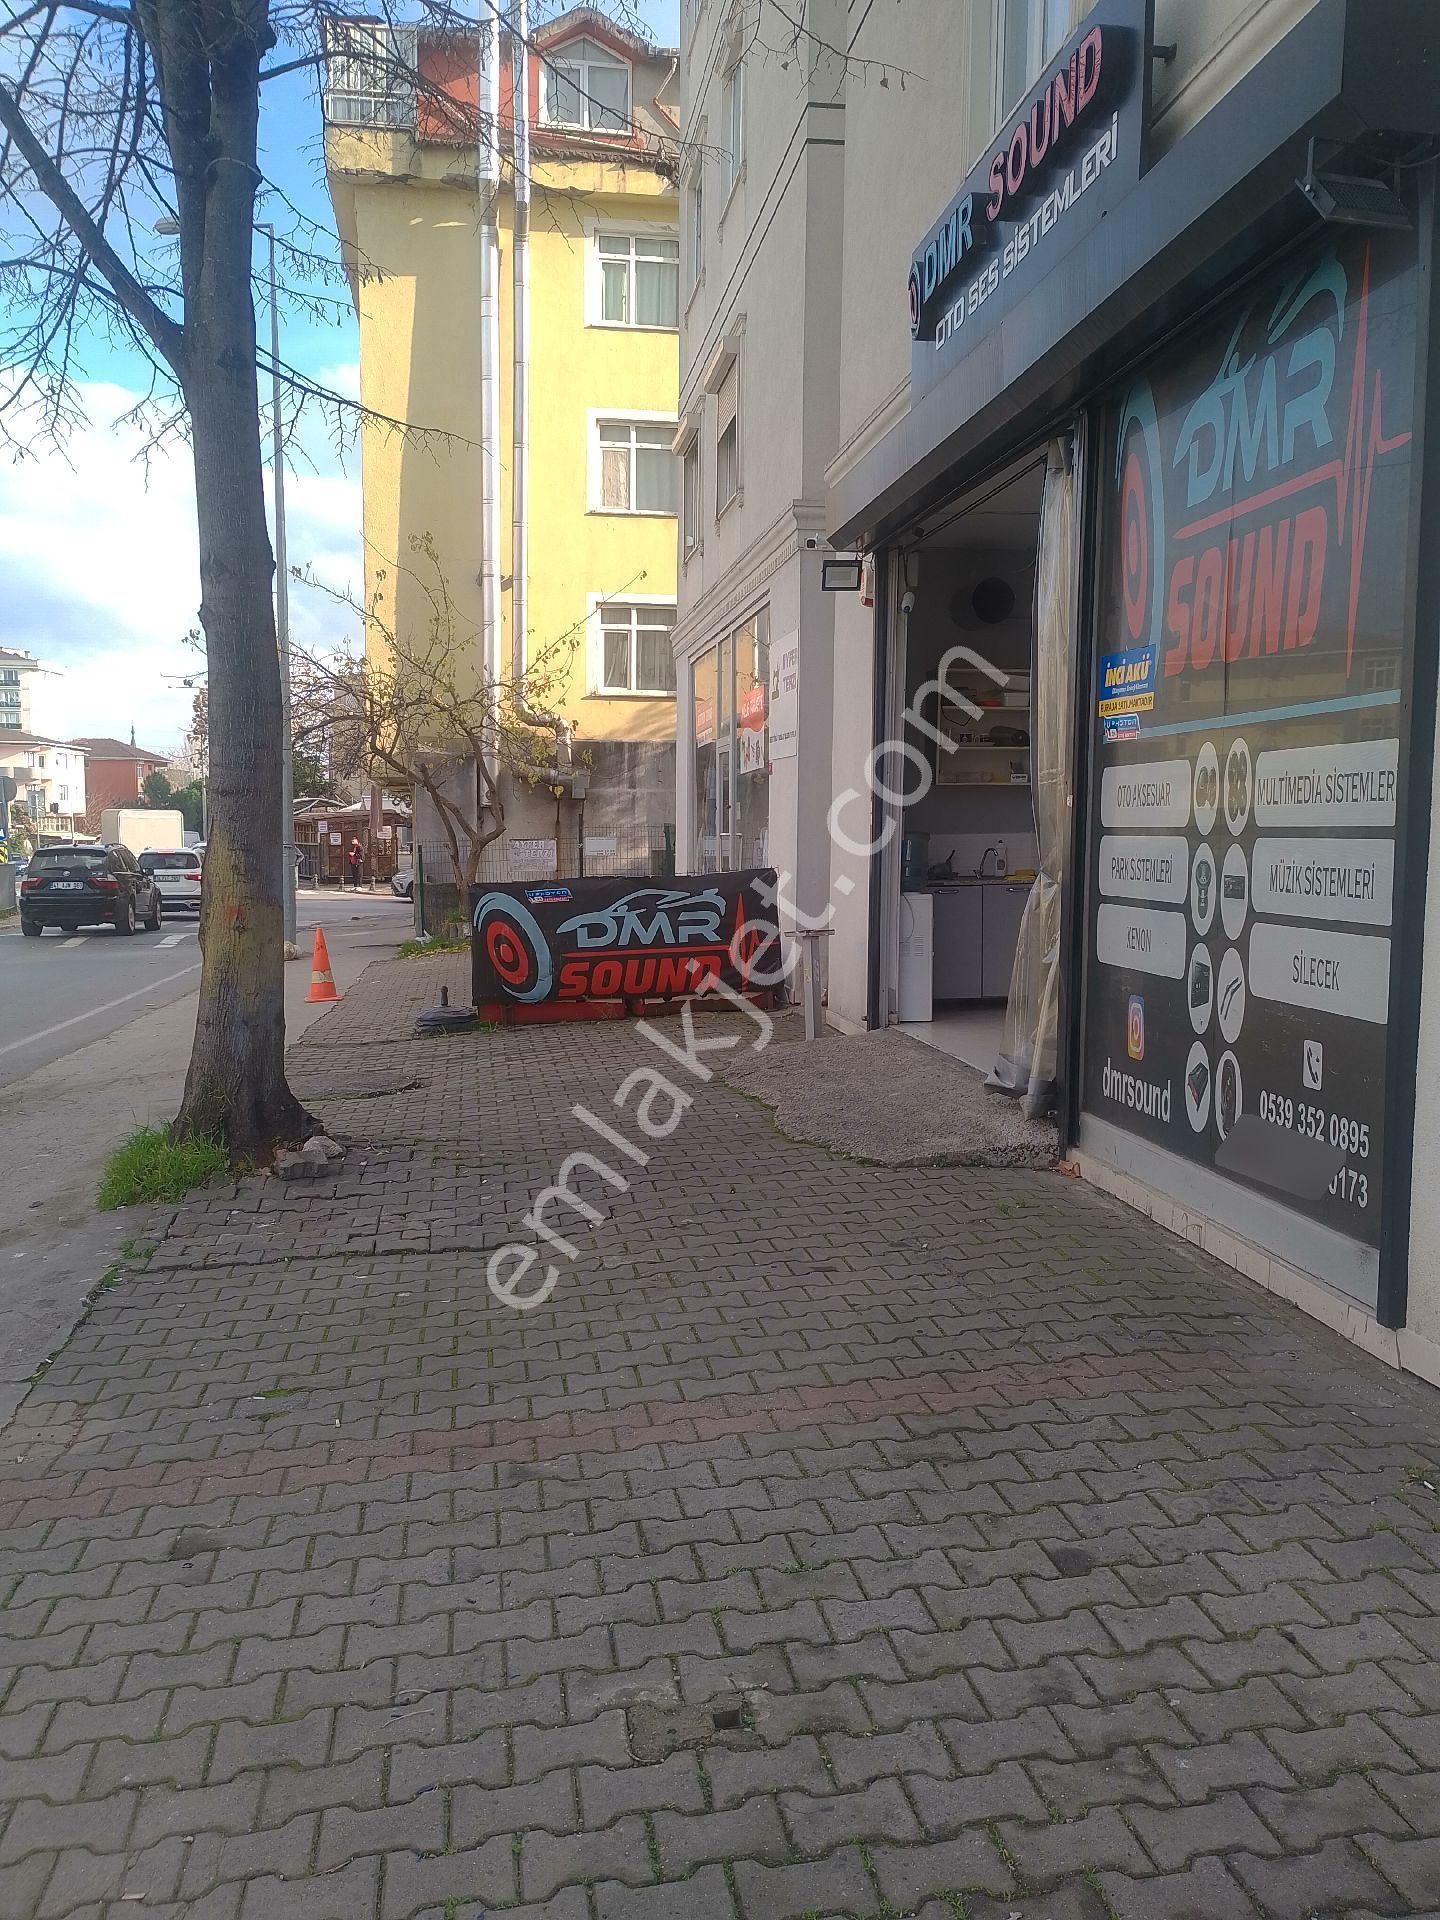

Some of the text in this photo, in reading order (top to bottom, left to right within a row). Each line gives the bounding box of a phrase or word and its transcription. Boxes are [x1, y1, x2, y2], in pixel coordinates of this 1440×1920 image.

[923, 25, 1103, 304] DMR SOUND
[935, 110, 1119, 350] OTO SES SİSTEMLERİ
[1173, 326, 1336, 508] DMR
[1164, 505, 1328, 678] SOUND
[1117, 785, 1131, 808] OTO
[1257, 768, 1322, 805] MULTİMEDİA
[1111, 857, 1129, 881] PARK
[1269, 855, 1375, 900] MÜZİK SİSTEMLERİ
[557, 908, 723, 948] DMR
[558, 955, 721, 997] SOUND
[1292, 950, 1340, 991] SİLECEK
[1102, 1057, 1172, 1124] dmrsound
[1259, 1089, 1370, 1158] 0539 352 0895
